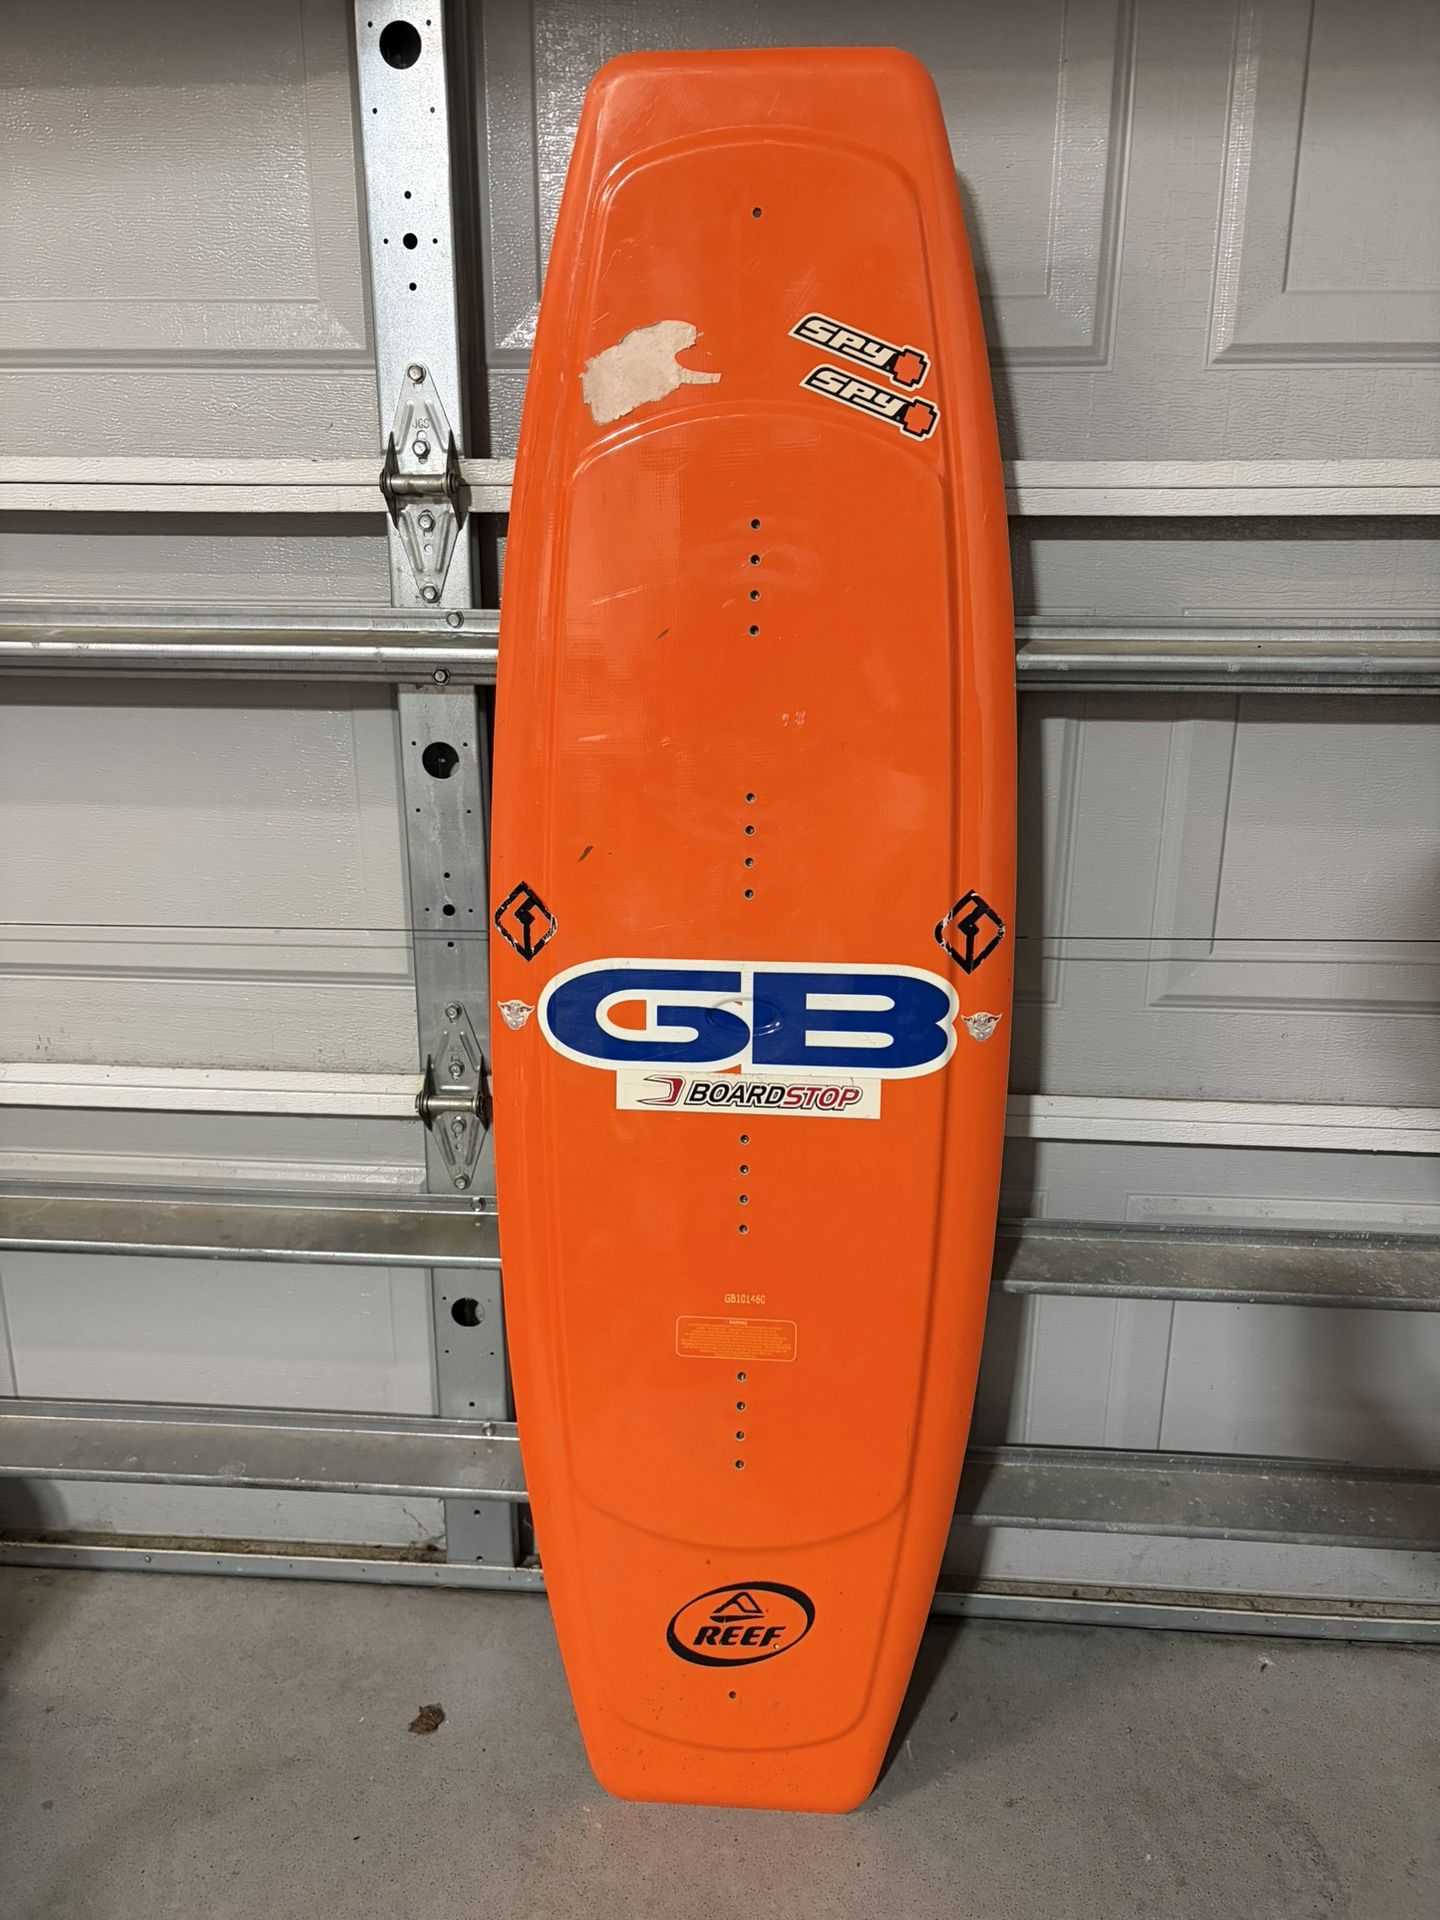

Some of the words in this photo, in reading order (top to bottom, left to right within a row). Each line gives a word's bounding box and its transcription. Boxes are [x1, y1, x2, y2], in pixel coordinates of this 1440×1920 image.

[799, 317, 897, 367] SPY
[809, 369, 907, 418] SPY
[546, 968, 951, 1069] GB
[687, 1081, 862, 1109] BOARDSTOP
[693, 1625, 787, 1647] REEF
